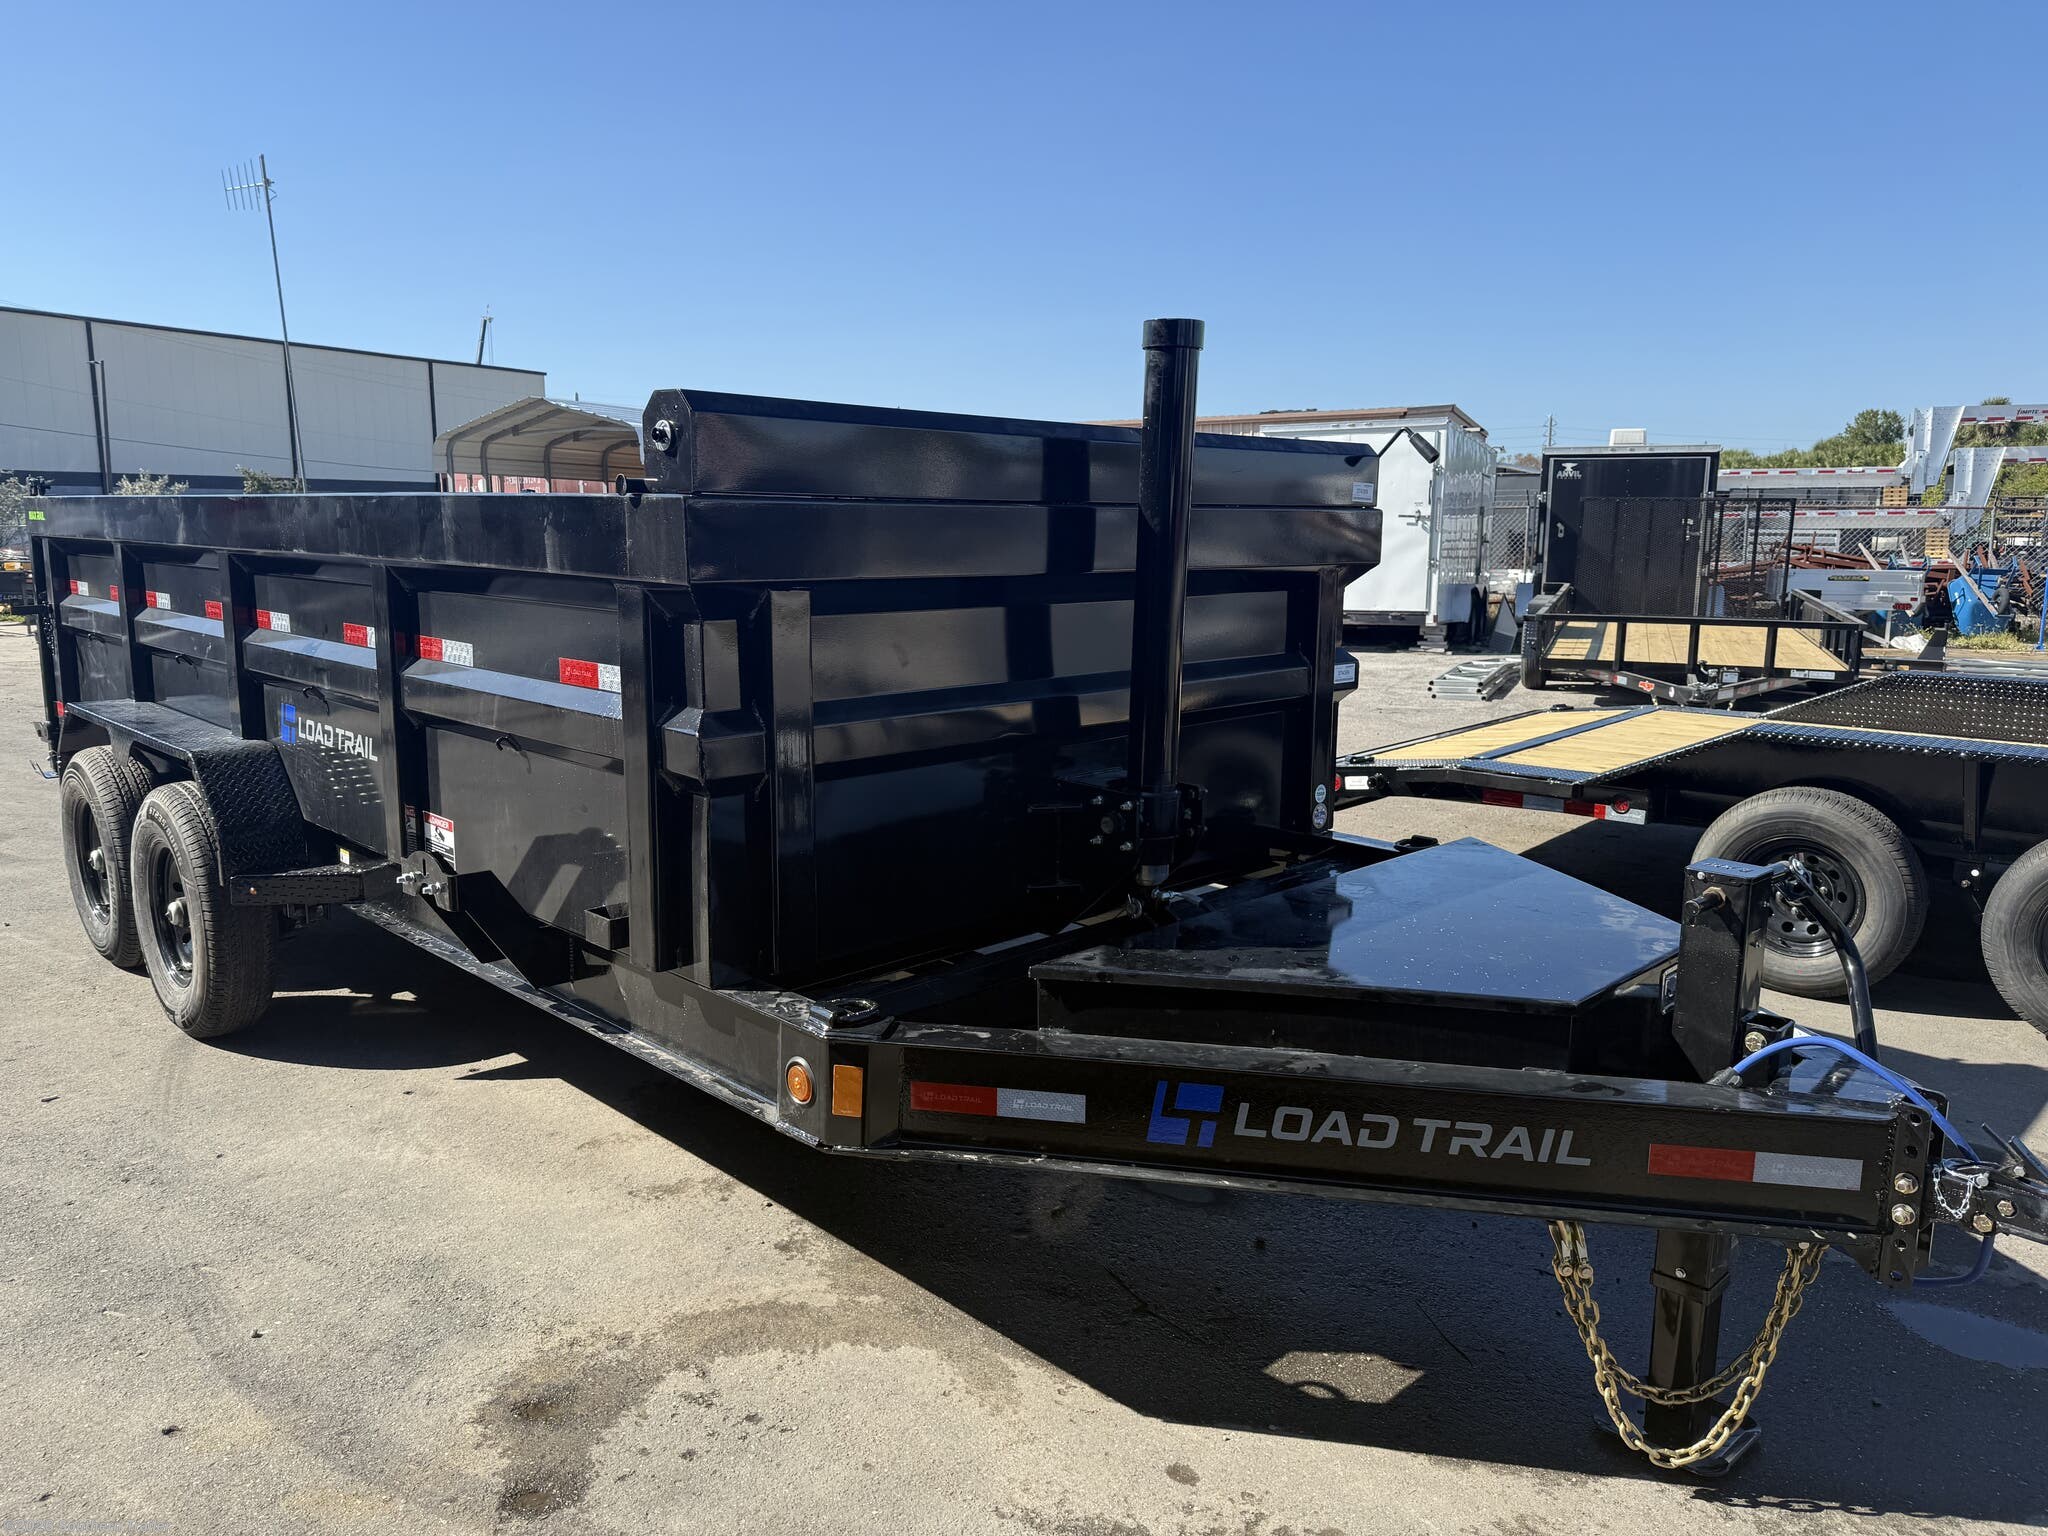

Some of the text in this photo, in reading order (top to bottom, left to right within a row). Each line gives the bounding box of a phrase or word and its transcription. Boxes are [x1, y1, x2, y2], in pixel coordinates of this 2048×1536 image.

[298, 716, 378, 762] LOAD TRAIL
[1024, 1101, 1075, 1112] LOAD TRAIL
[1233, 1102, 1592, 1167] LOAD TRAIL
